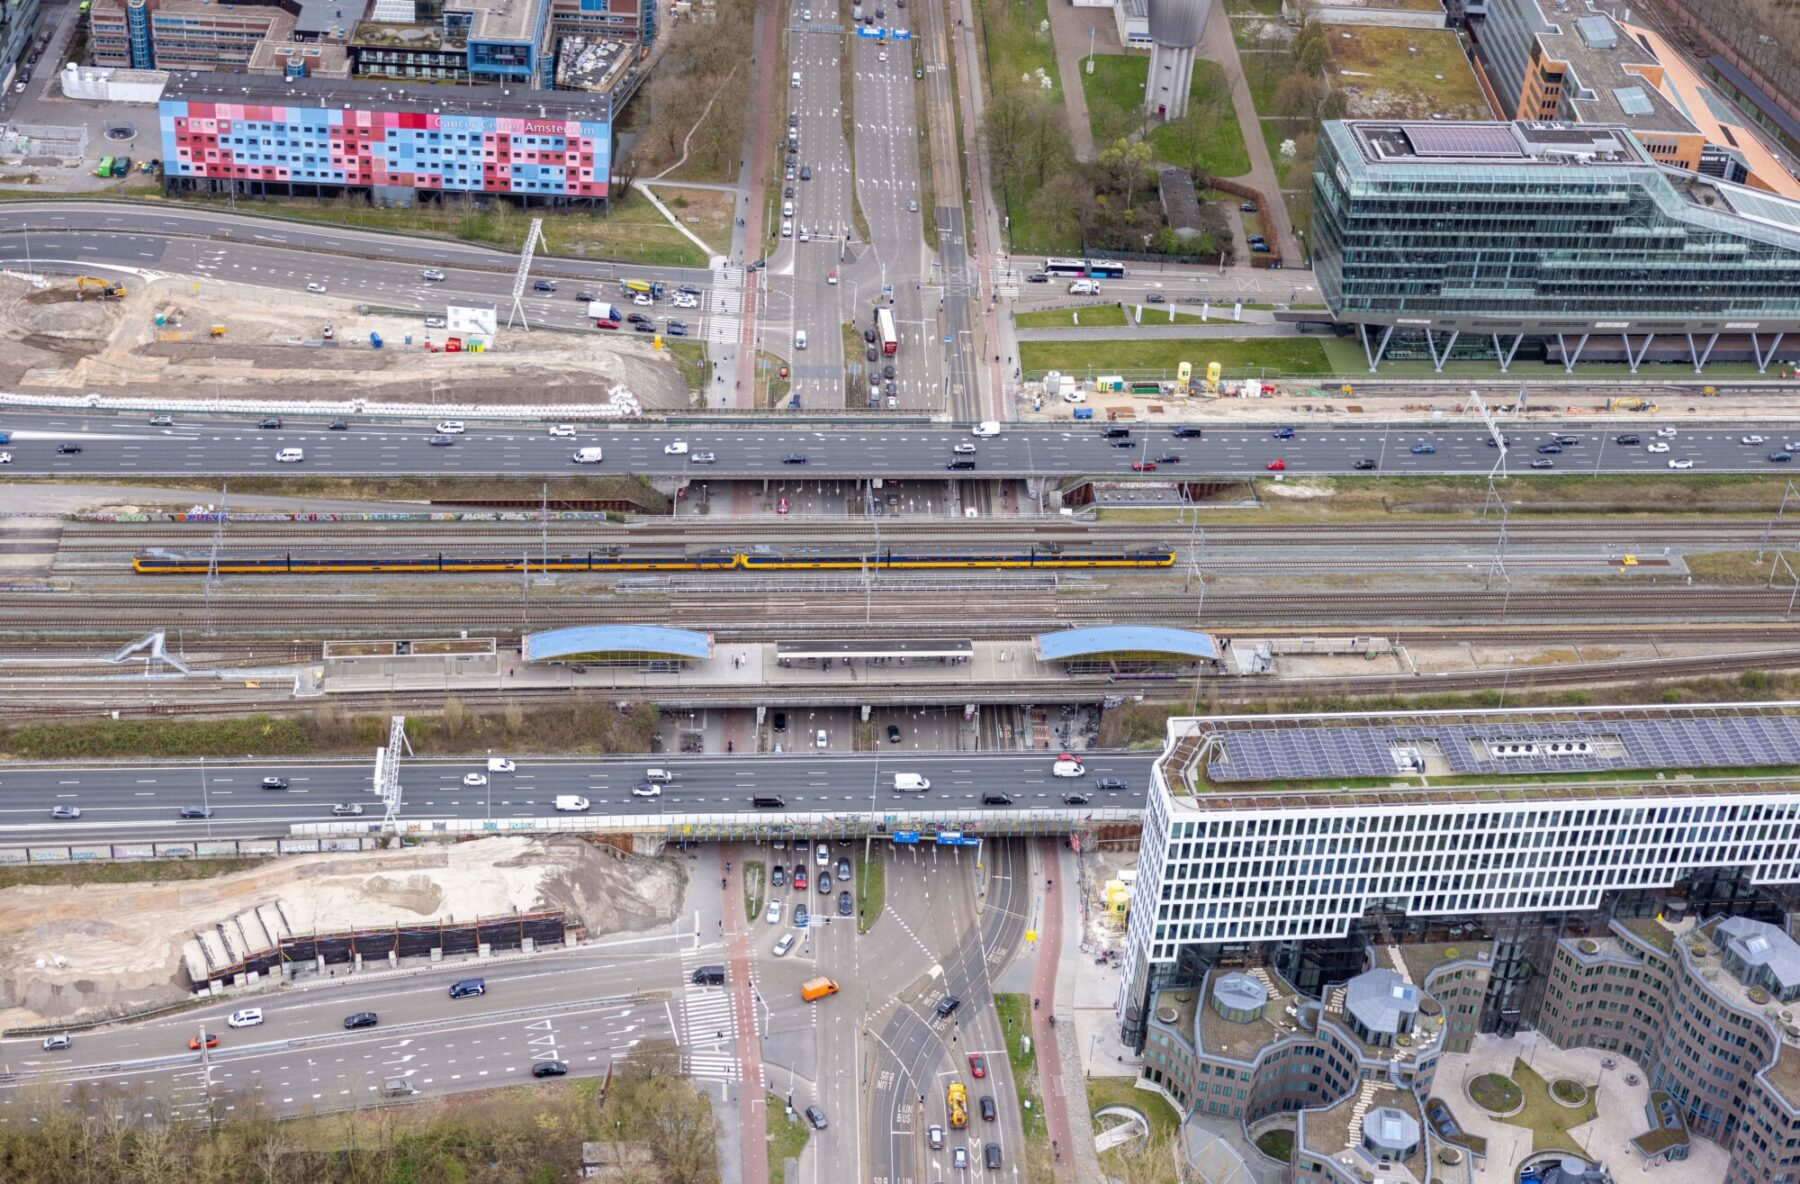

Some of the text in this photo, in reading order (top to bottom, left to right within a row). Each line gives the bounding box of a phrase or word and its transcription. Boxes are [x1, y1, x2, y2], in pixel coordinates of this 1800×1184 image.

[434, 117, 594, 135] Cancer Center Amsterdam
